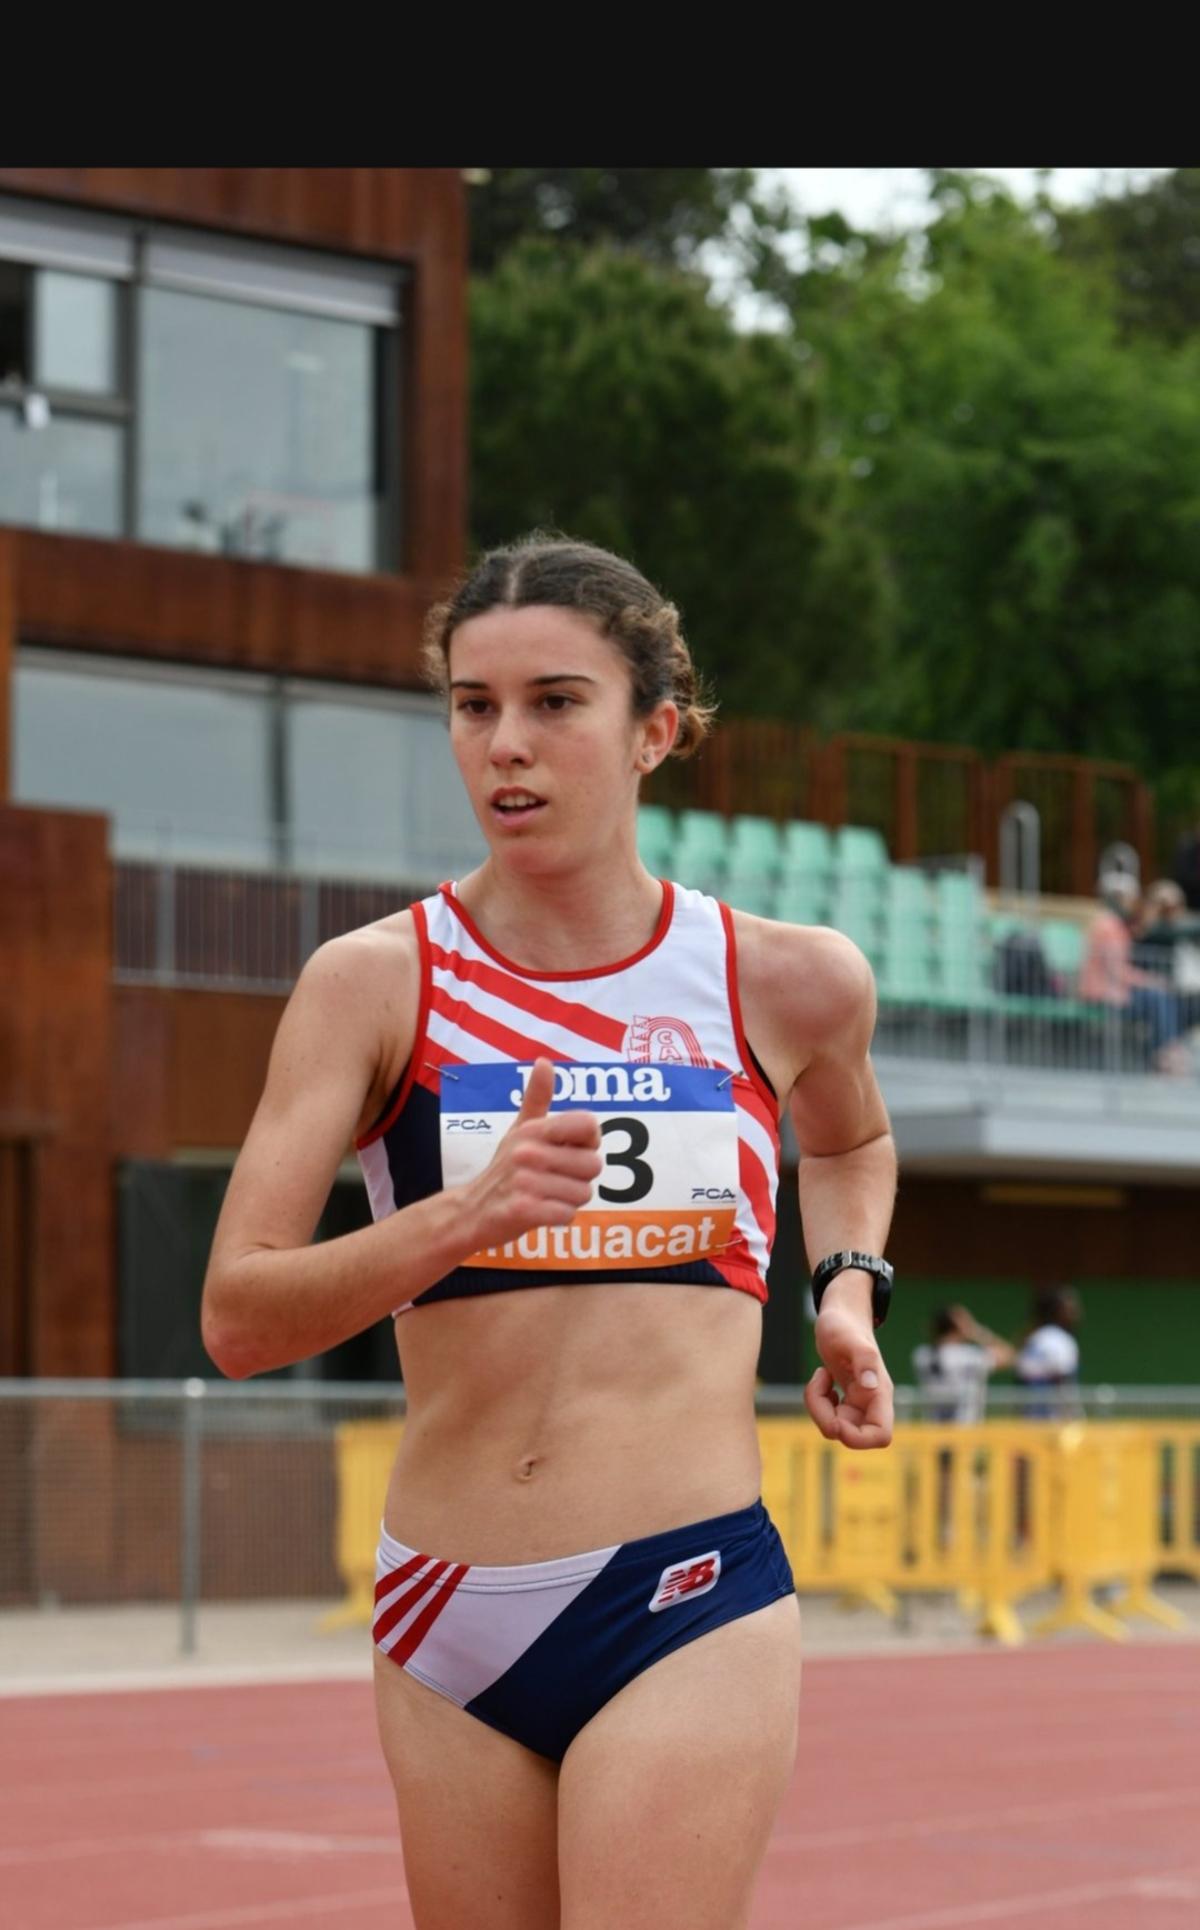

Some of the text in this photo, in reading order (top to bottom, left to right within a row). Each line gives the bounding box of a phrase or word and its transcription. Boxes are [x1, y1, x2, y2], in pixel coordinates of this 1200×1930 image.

[446, 1119, 491, 1130] FCA
[598, 1117, 654, 1203] 3
[691, 1188, 735, 1199] FCA
[474, 1217, 715, 1260] utuacat
